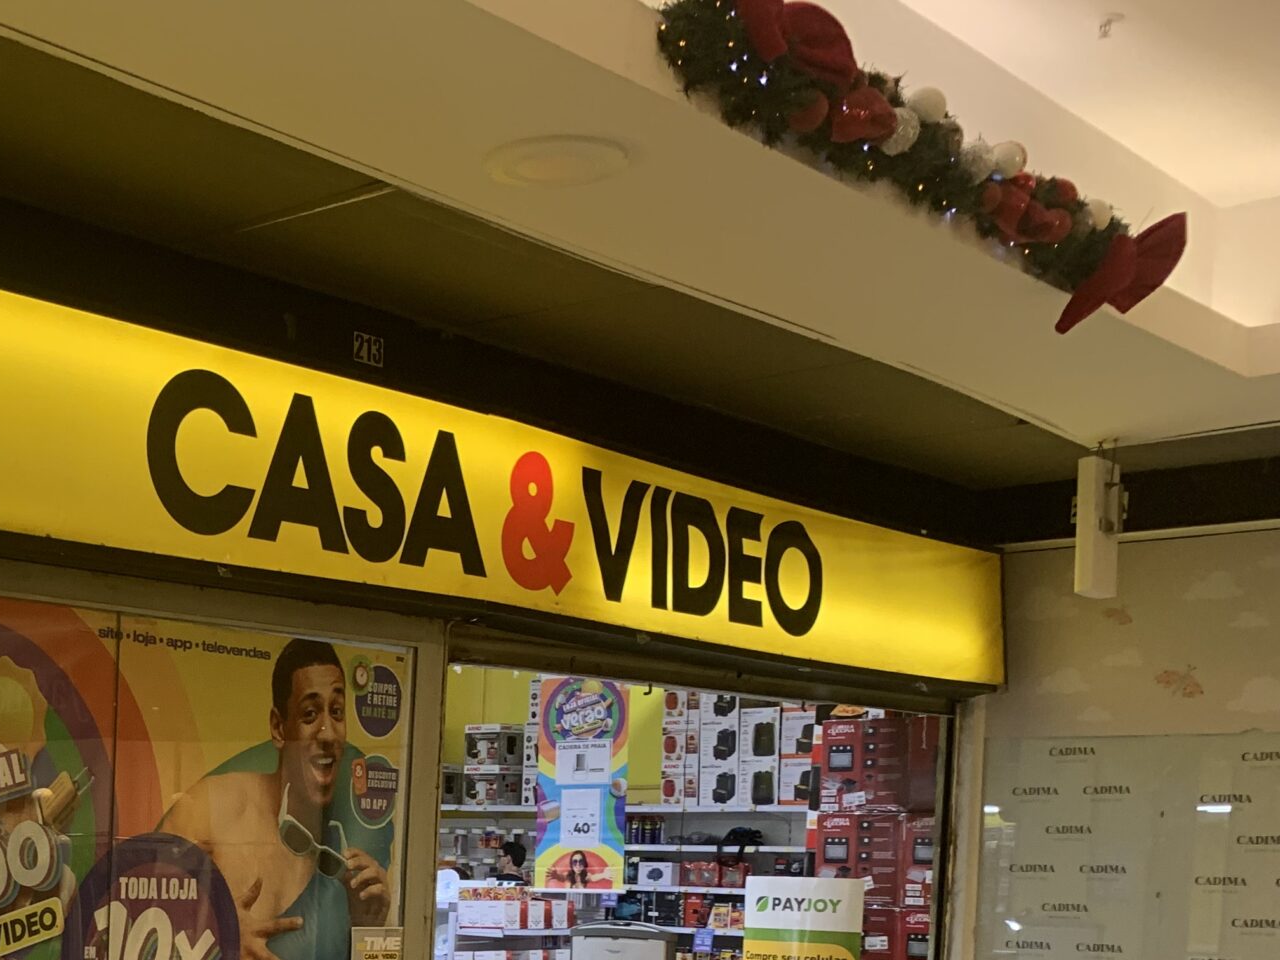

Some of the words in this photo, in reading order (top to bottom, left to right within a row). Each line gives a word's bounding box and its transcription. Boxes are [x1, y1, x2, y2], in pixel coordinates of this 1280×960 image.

[354, 334, 382, 366] 213
[146, 368, 487, 578] CASA
[582, 467, 823, 637] VIDEO
[98, 627, 123, 641] site
[133, 629, 157, 646] loja
[166, 636, 193, 652] app
[201, 640, 271, 661] televendas
[1049, 747, 1095, 757] CADIMA
[1012, 787, 1059, 796] CADIMA
[1083, 785, 1131, 795] CADIMA
[361, 798, 370, 809] NO
[373, 799, 387, 810] APP
[1200, 794, 1252, 803] CADIMA
[1046, 825, 1092, 835] CADIMA
[1009, 864, 1055, 873] CADIMA
[1079, 864, 1126, 875] CADIMA
[1195, 876, 1246, 887] CADIMA
[119, 877, 157, 900] TODA
[161, 878, 197, 900] LOJA
[772, 896, 842, 913] PAYJOY
[1042, 903, 1088, 913] CADIMA
[364, 937, 401, 951] TIME
[1005, 940, 1051, 951] CADIMA
[1076, 943, 1123, 954] CADIMA
[84, 946, 96, 960] EM
